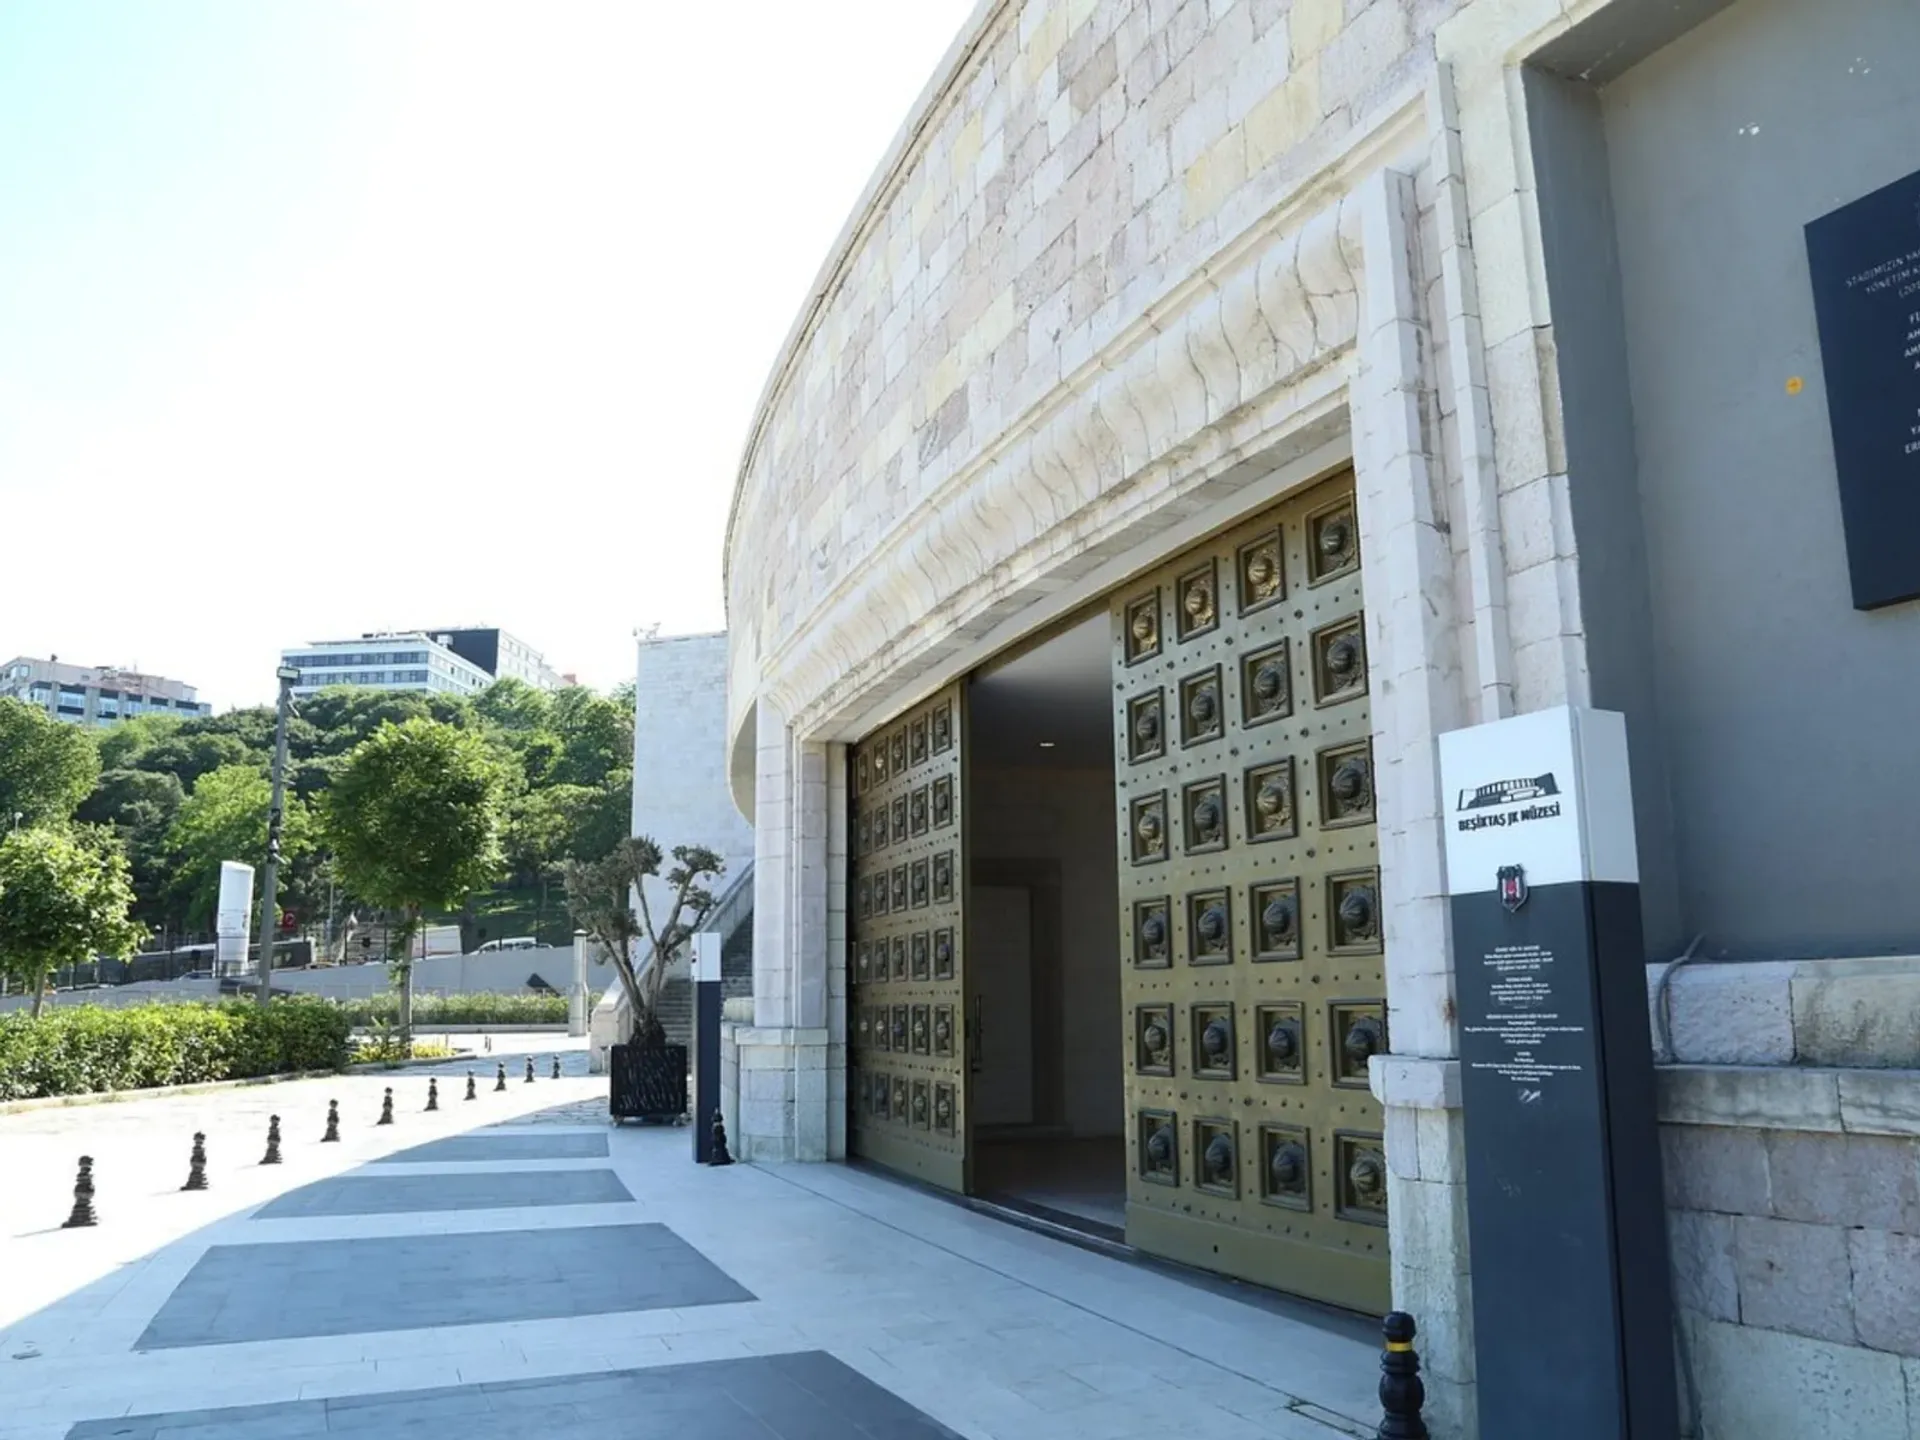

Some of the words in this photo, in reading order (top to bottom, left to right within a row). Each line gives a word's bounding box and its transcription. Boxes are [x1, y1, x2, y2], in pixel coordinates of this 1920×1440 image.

[1458, 813, 1506, 832] BEŞİKTAŞ
[1507, 811, 1519, 826] JK
[1520, 801, 1561, 821] MÜZESİ
